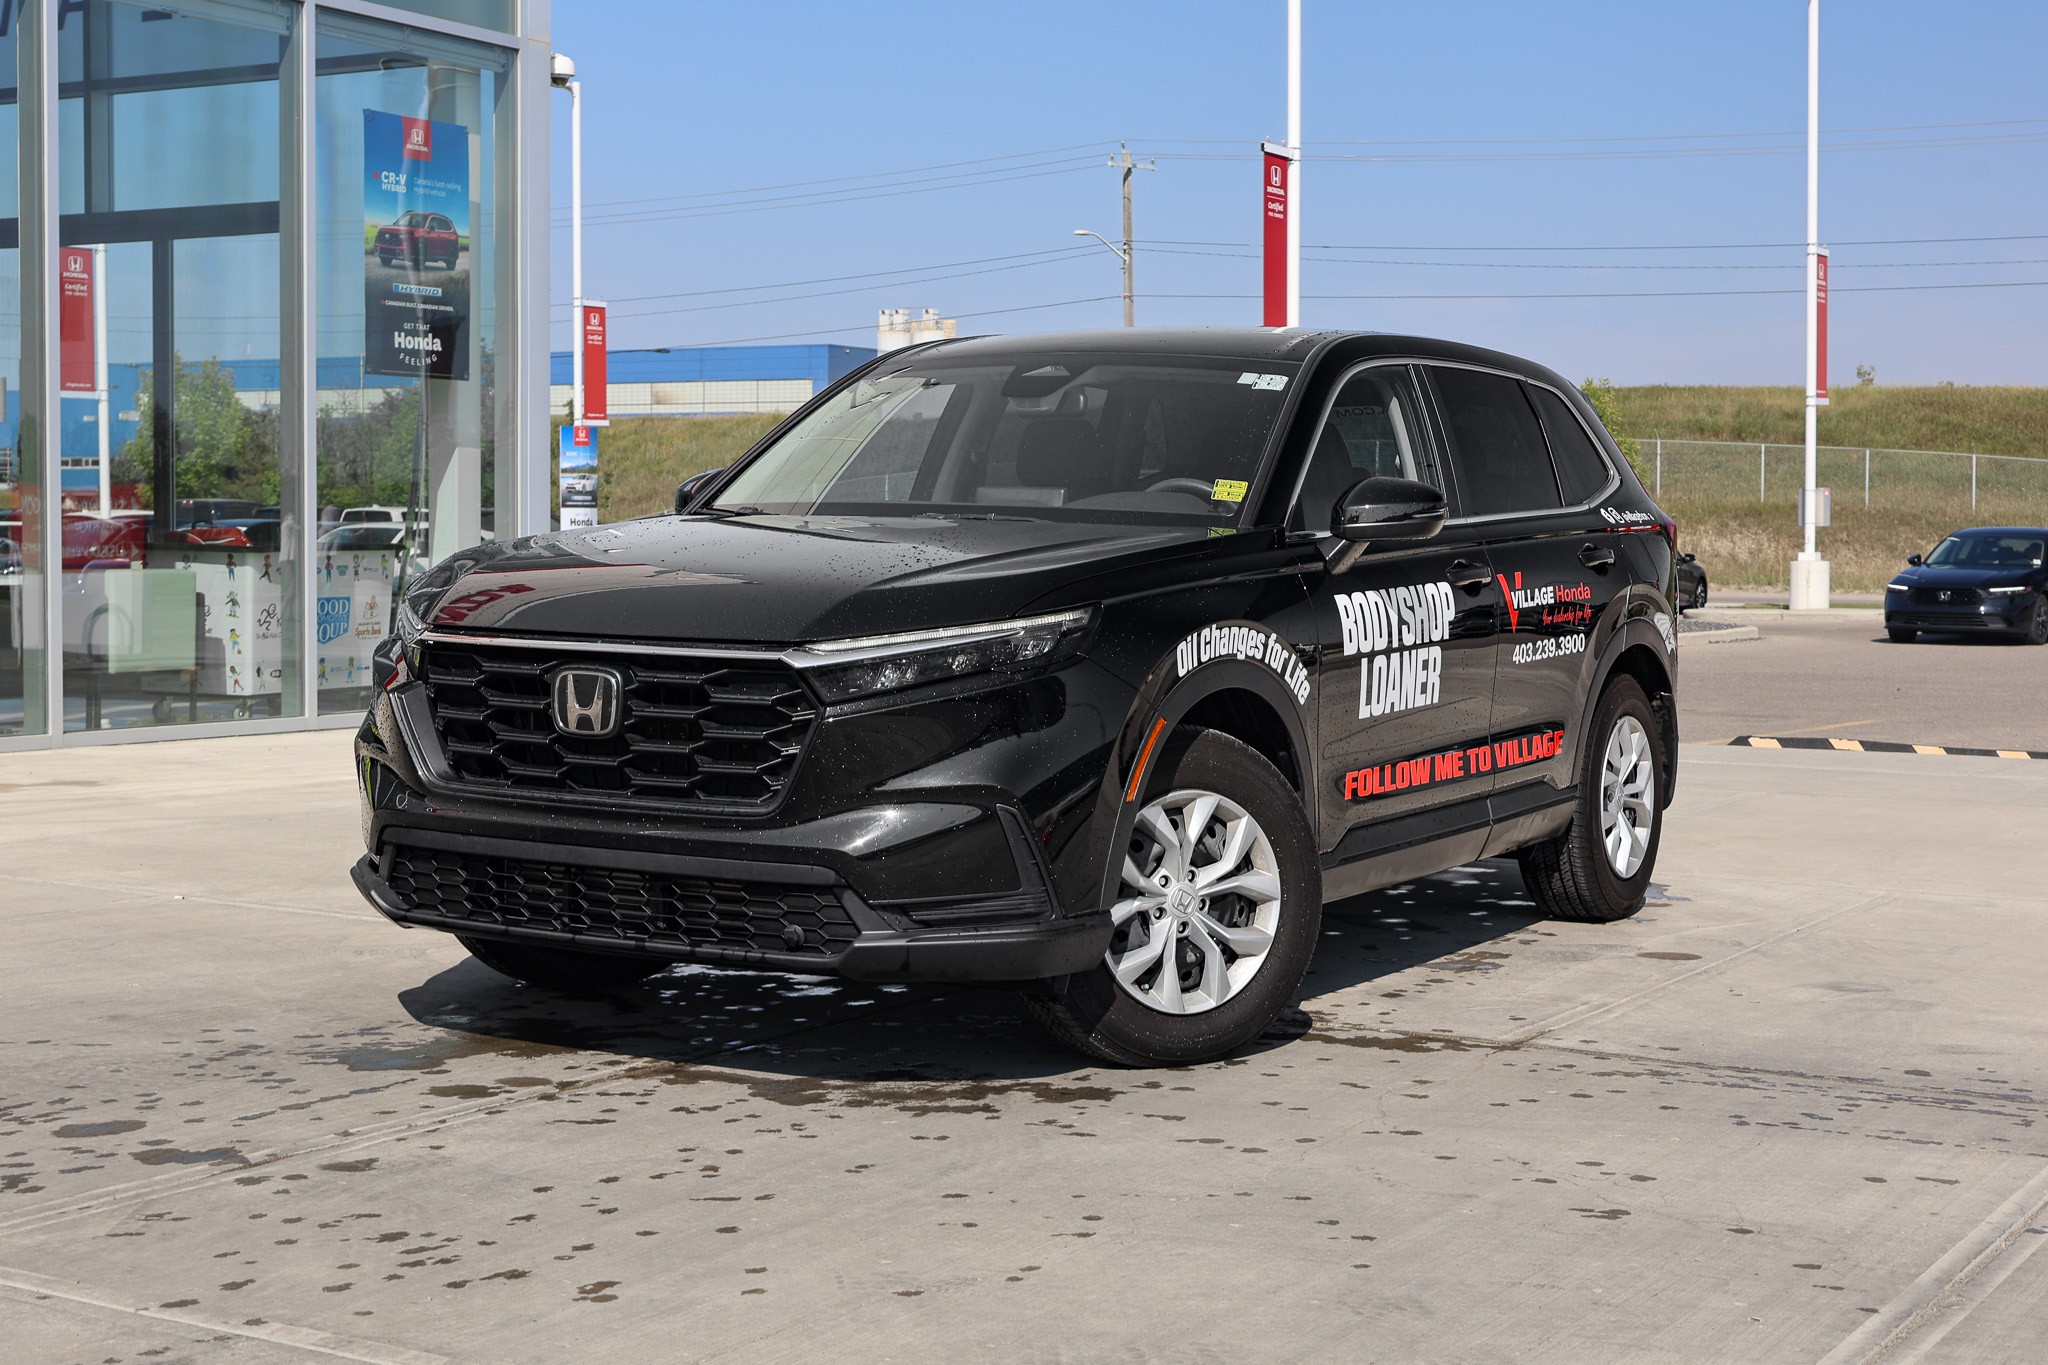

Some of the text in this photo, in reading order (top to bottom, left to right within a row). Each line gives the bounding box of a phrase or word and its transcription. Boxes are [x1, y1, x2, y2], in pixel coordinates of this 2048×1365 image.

[407, 144, 428, 152] HONDA
[382, 171, 406, 185] CR-V
[382, 182, 406, 193] HYBRID
[400, 285, 439, 296] HYBRID
[394, 332, 442, 351] Honda
[400, 353, 438, 366] FEELING
[1511, 582, 1591, 610] VILLAGE Honda
[317, 600, 349, 614] OOD
[1554, 606, 1574, 626] dealership
[1584, 603, 1592, 624] life
[317, 614, 348, 622] OMOTIVE
[1334, 582, 1456, 656] BODYSHOP
[317, 622, 348, 642] OUP
[1512, 633, 1585, 664] 403.239.3900
[1176, 624, 1311, 706] Oil Changes for Life
[1358, 646, 1442, 720] LOANER
[1344, 730, 1564, 800] FOLLOW ME TO VILLAGE
